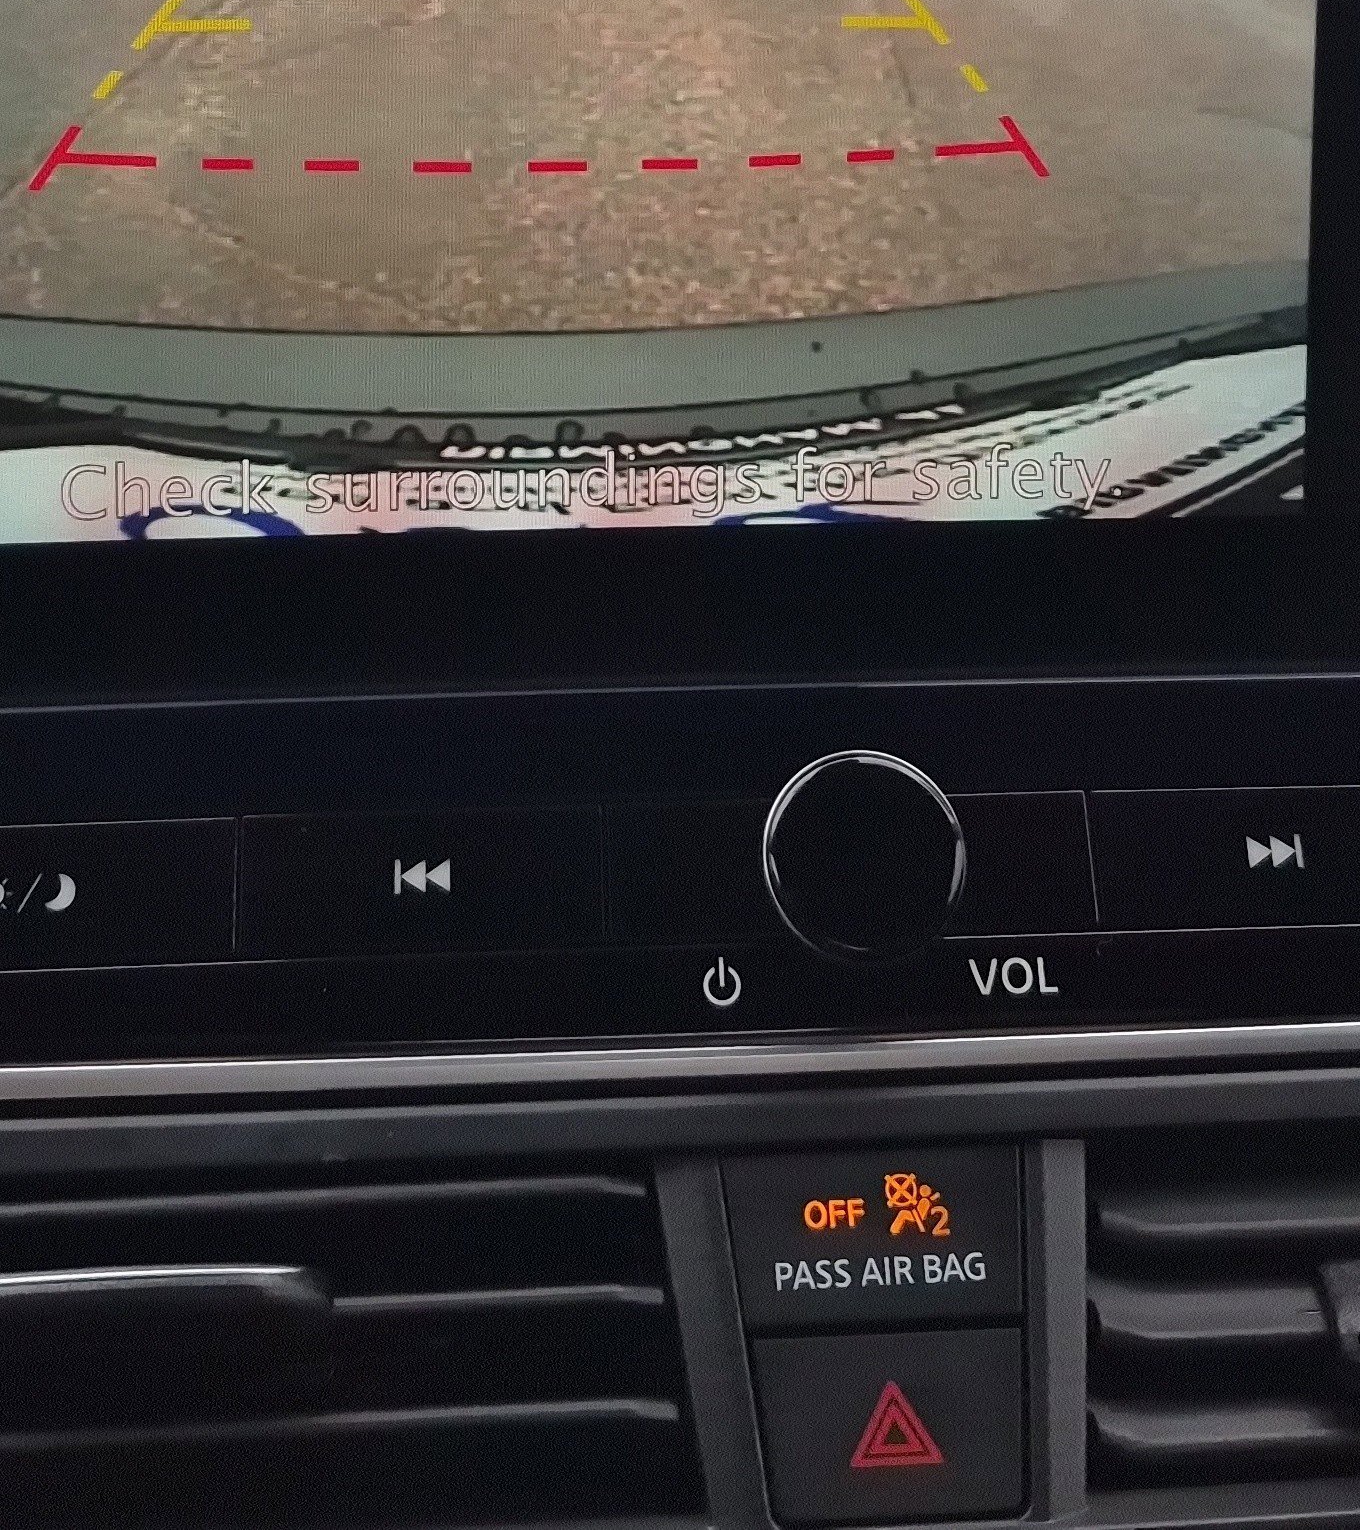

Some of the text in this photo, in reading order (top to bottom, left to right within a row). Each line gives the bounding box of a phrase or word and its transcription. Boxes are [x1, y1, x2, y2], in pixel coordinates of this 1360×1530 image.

[61, 458, 278, 520] Check
[305, 449, 763, 518] surroundings
[791, 446, 888, 503] for
[968, 956, 1059, 996] VOL
[803, 1198, 865, 1230] OFF
[774, 1251, 987, 1292] PASS AIR BAG
